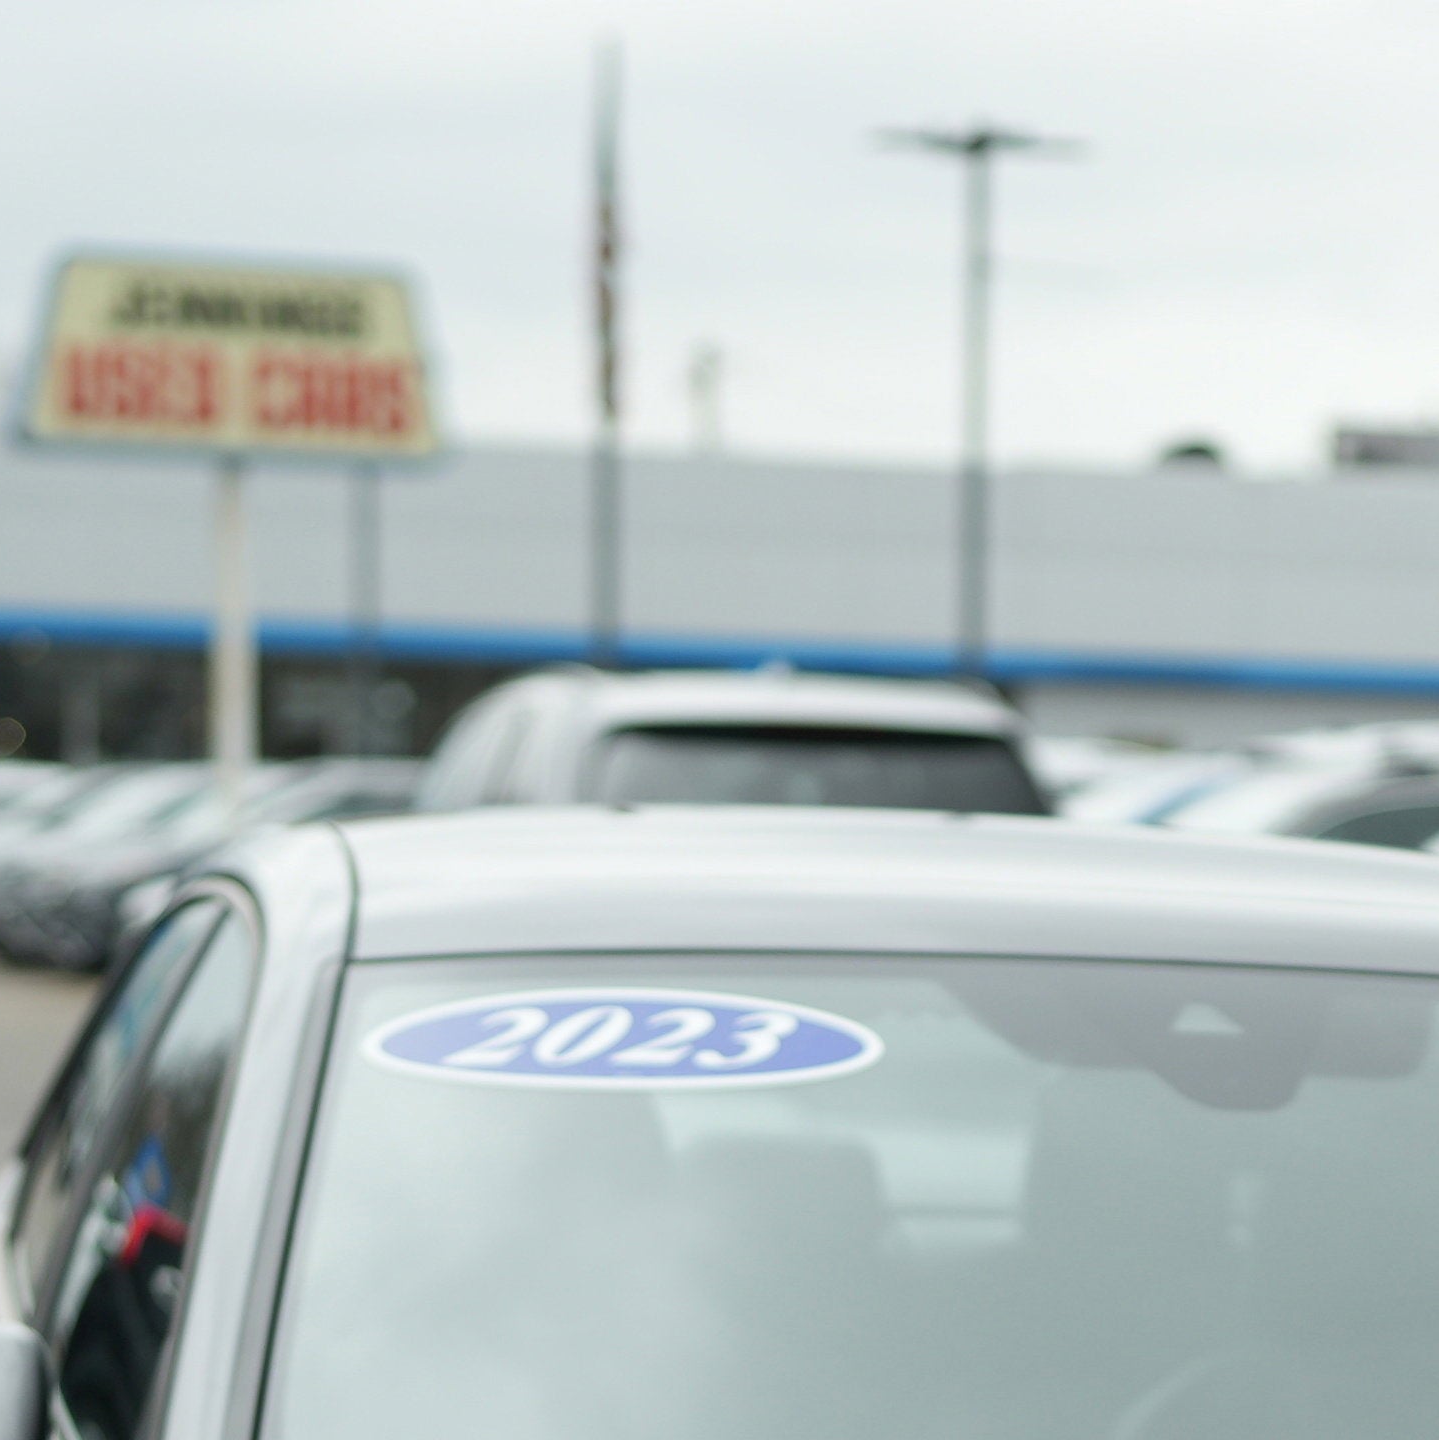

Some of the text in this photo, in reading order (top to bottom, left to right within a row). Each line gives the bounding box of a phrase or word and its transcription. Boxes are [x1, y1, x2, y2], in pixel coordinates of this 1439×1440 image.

[63, 346, 411, 436] USED CARS
[443, 1007, 801, 1070] 2023
